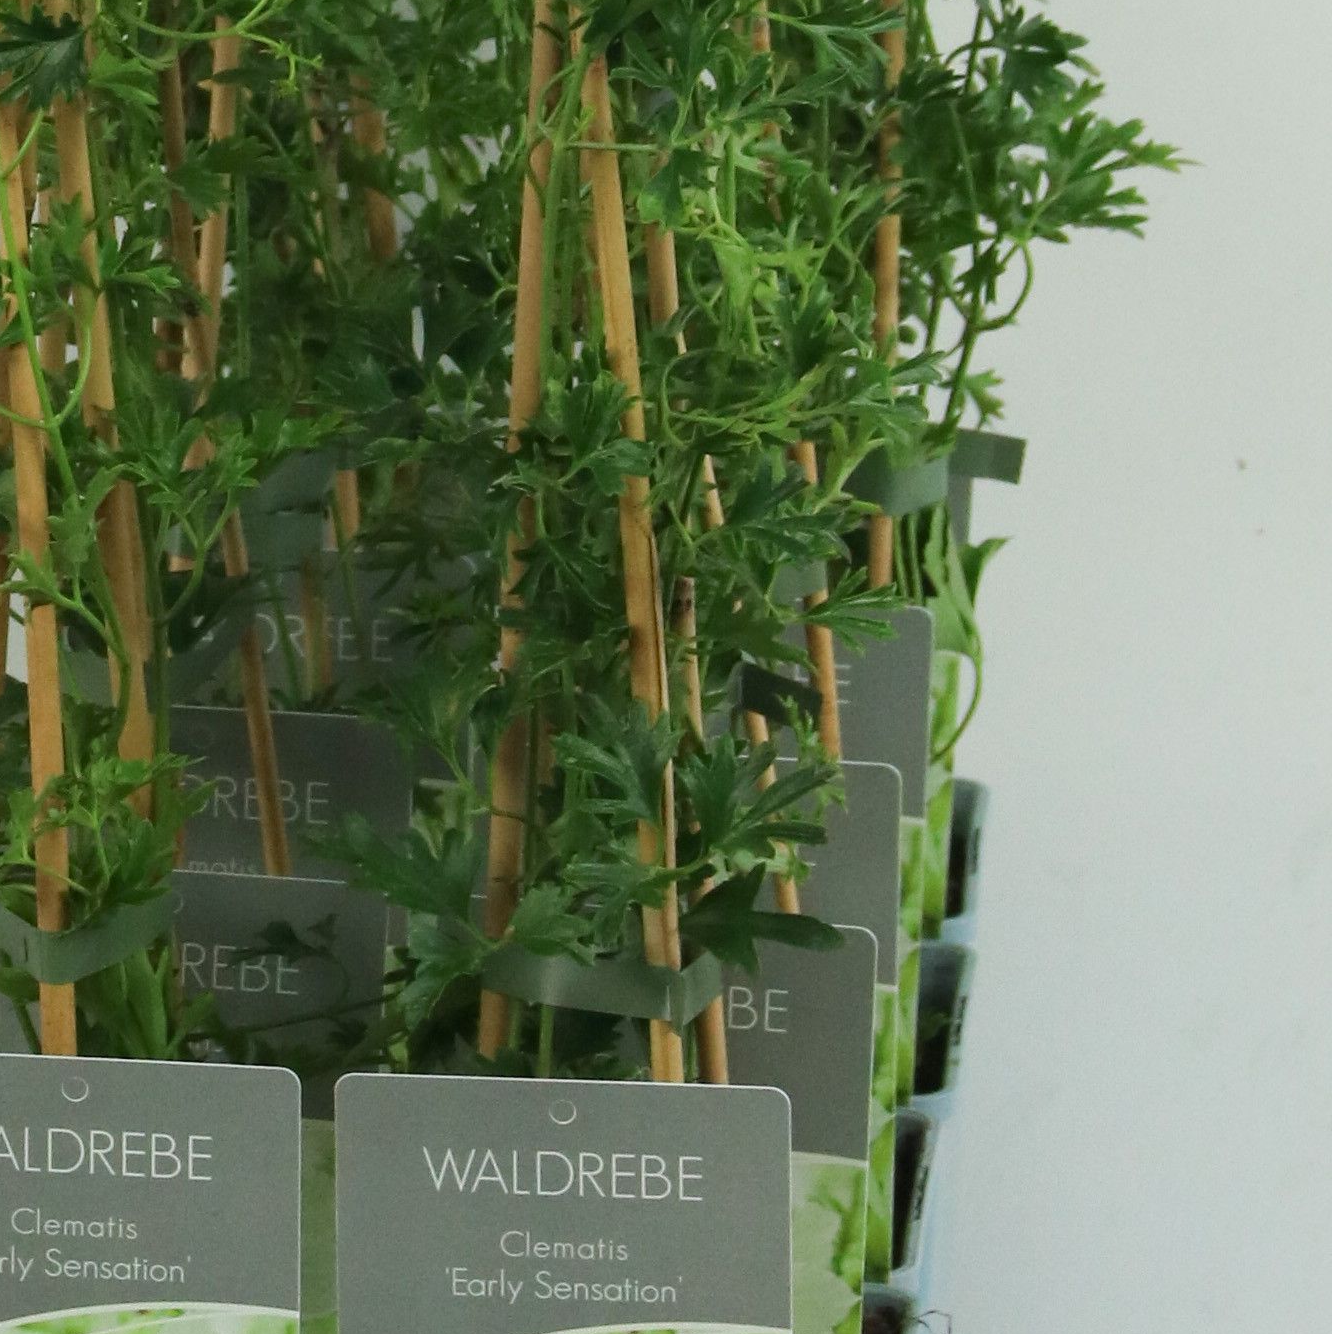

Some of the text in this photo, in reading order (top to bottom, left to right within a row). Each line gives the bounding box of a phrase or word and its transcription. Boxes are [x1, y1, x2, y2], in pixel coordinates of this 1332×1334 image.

[180, 941, 300, 996] REBE
[422, 1145, 704, 1202] WALDREBE
[10, 1207, 139, 1241] Clematis
[499, 1230, 629, 1262] Clematis
[44, 1248, 192, 1285] Sensation'
[444, 1266, 683, 1305] 'Early Sensation'
